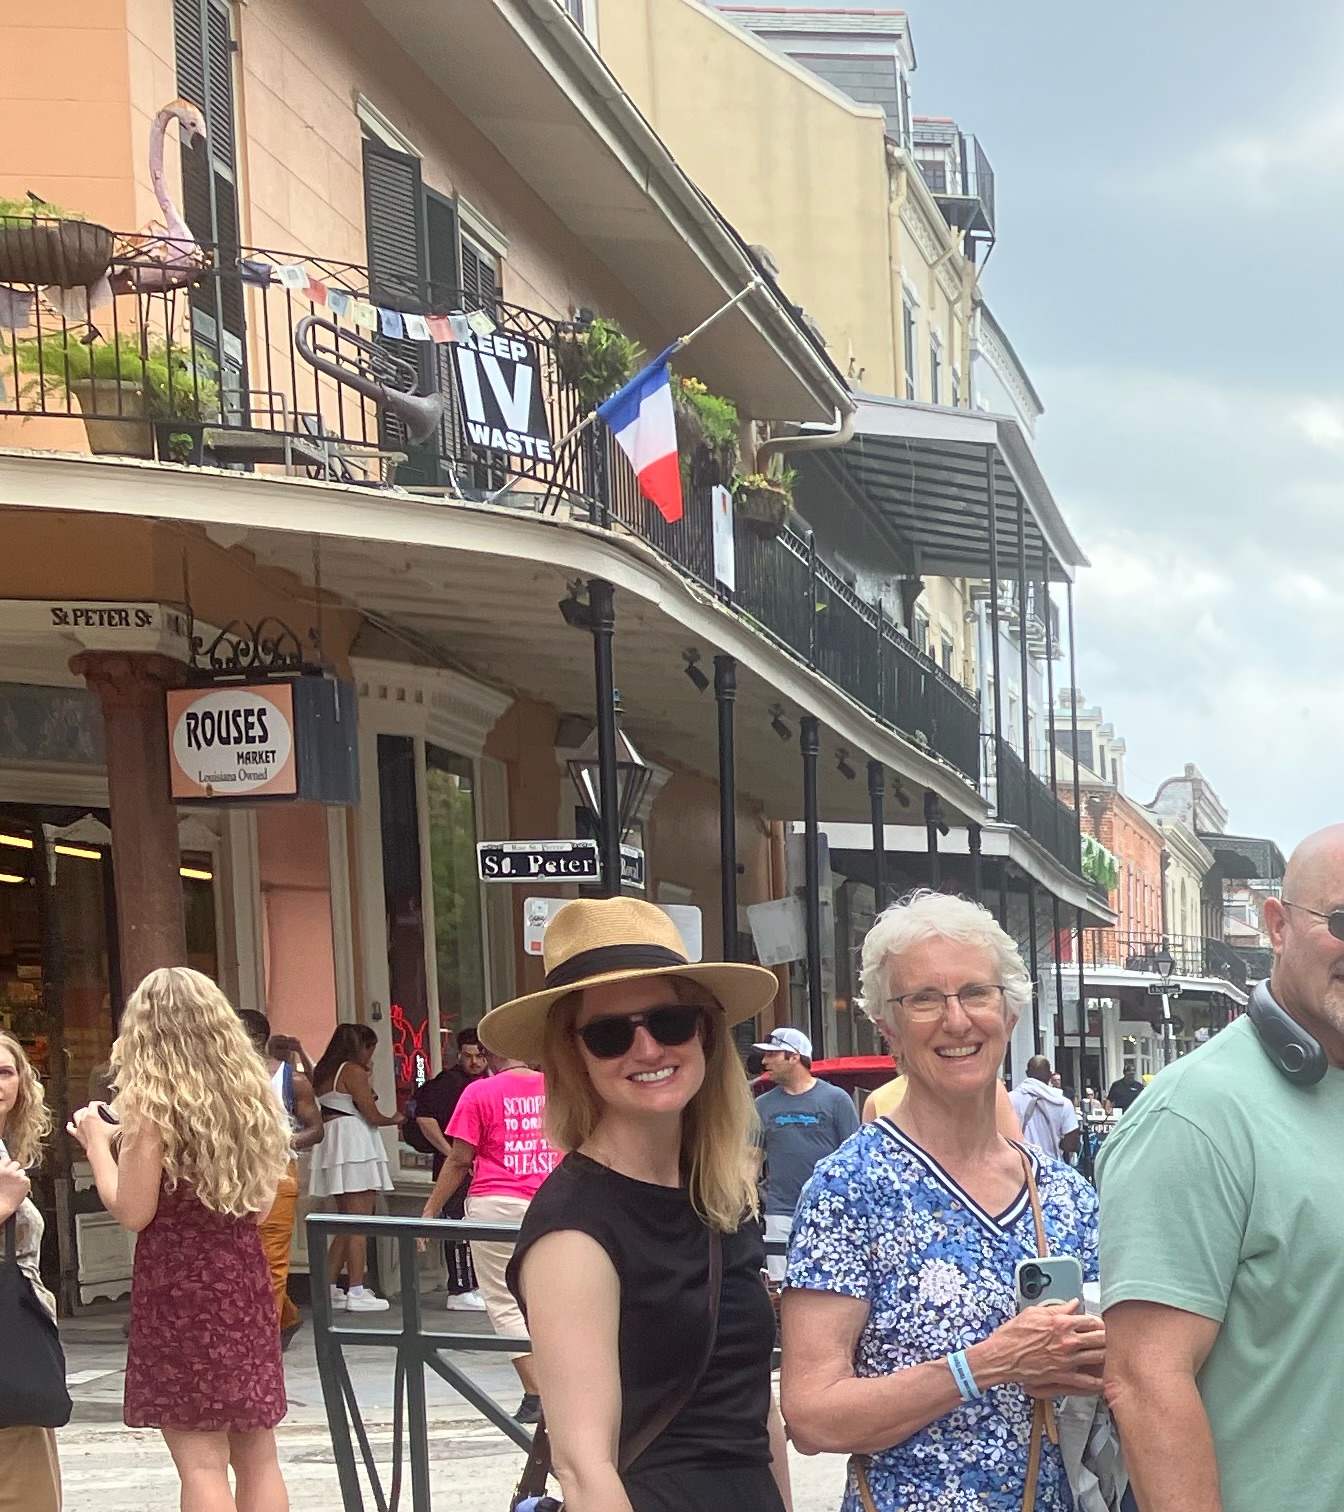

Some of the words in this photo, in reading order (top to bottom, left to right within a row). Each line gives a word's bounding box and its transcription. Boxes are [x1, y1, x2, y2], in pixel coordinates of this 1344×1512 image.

[457, 347, 533, 433] IV
[467, 422, 552, 460] WASTE
[72, 608, 130, 627] PETER
[186, 708, 269, 751] ROUSES
[237, 750, 276, 765] MARKET
[198, 770, 237, 783] Louisiana
[238, 767, 268, 781] Owned
[528, 855, 593, 873] Peter
[504, 1118, 519, 1131] TO
[503, 1151, 558, 1175] PLEASE
